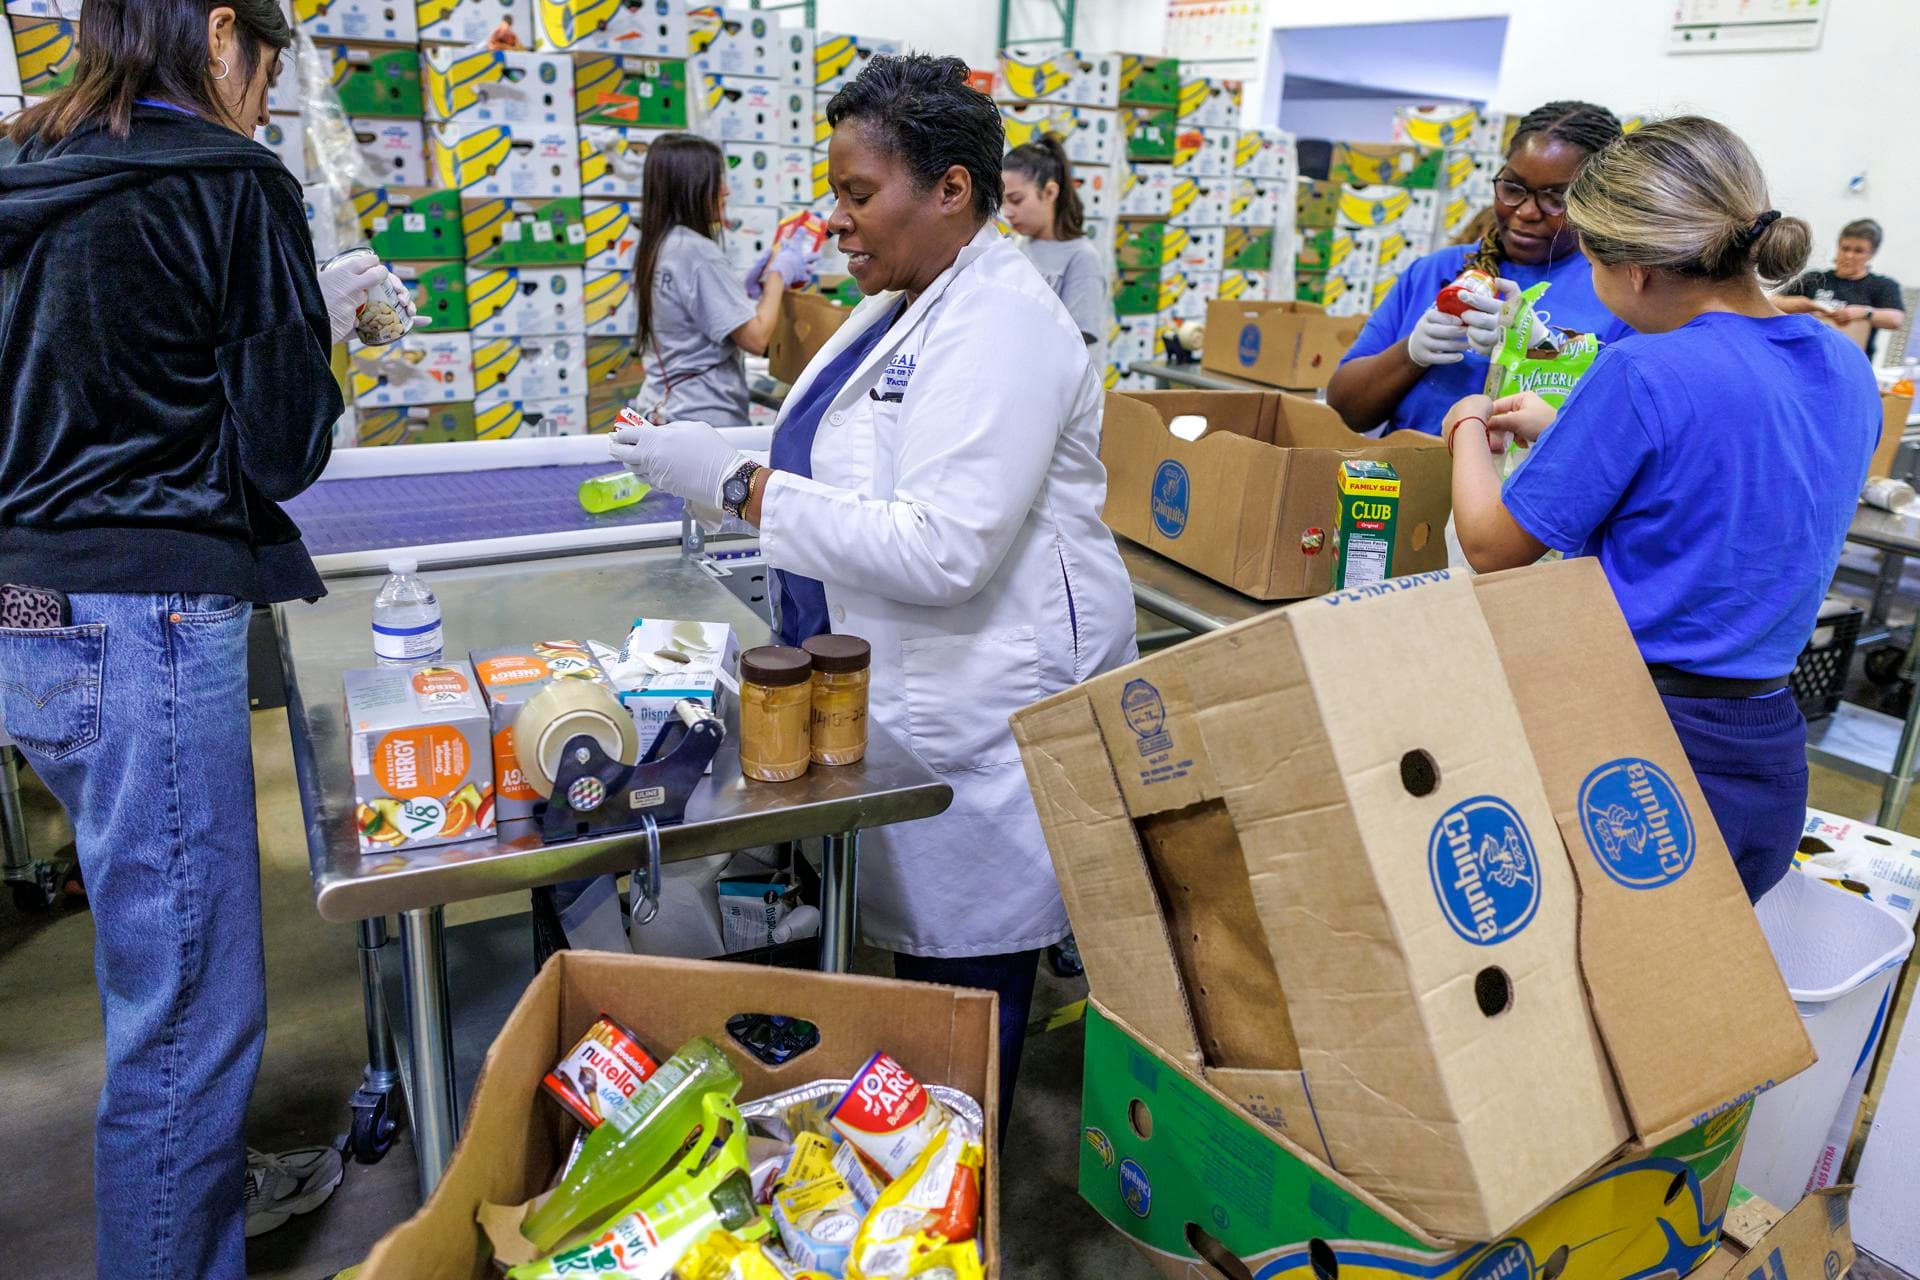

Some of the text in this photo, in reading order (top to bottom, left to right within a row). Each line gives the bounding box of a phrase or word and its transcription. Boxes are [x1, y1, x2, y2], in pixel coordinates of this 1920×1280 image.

[1512, 367, 1580, 392] WATERL
[1350, 482, 1398, 492] FAMILY SIZE
[1152, 495, 1186, 528] Chiquita
[1351, 500, 1392, 521] CLUB
[640, 708, 669, 724] Dispo
[394, 739, 417, 790] ENERGY
[636, 788, 658, 800] ULINE
[410, 805, 440, 834] V8
[1625, 762, 1687, 876] Chiquita
[1442, 810, 1499, 942] Chiquita
[581, 1045, 637, 1098] nutella
[857, 1057, 902, 1113] JOAN
[877, 1070, 915, 1114] ARC
[1821, 1146, 1837, 1172] EXTRA
